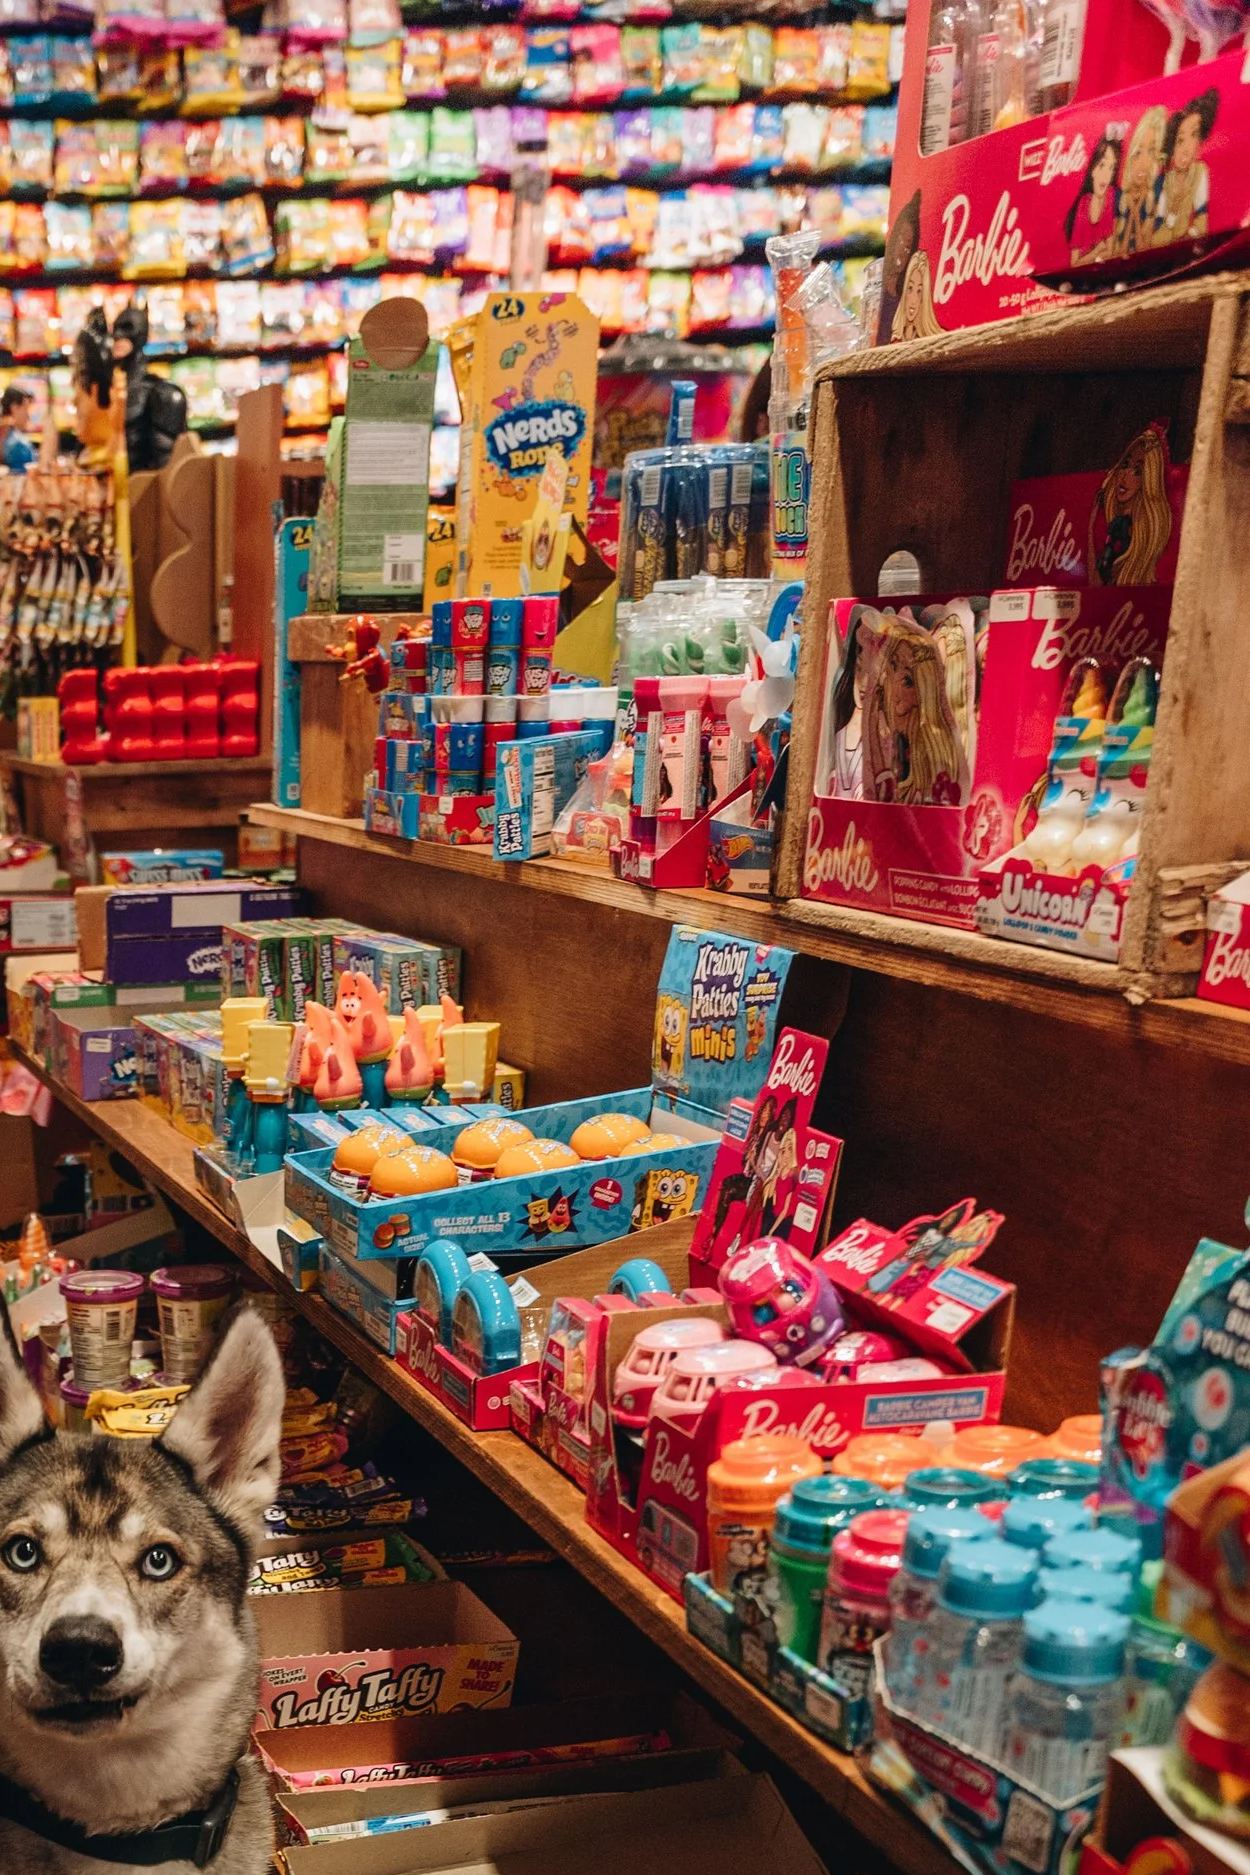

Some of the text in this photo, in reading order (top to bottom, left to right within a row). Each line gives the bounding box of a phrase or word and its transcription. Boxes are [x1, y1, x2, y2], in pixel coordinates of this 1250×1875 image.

[933, 190, 1030, 304] Barbie
[1006, 503, 1082, 582] Barbie
[1031, 600, 1158, 671] Barbie
[498, 814, 511, 855] Krabby
[803, 806, 879, 892] Barbie
[290, 946, 301, 983] Patties
[694, 942, 749, 988] Krabby
[322, 978, 335, 1011] rabby
[690, 983, 740, 1019] Patties
[690, 1024, 737, 1063] minis
[767, 1034, 816, 1096] Barbie
[397, 1233, 429, 1247] ACTUAL
[433, 1216, 474, 1227] COLLECT
[478, 1214, 495, 1225] ALL
[439, 1223, 504, 1236] CHARACTERS!
[822, 1228, 886, 1275] Barbie
[408, 1321, 440, 1384] Barbie
[741, 1398, 850, 1448] Barbie
[651, 1430, 700, 1502] Barbie
[273, 1676, 308, 1687] WRAPPER
[282, 1669, 304, 1679] EVERY
[468, 1658, 504, 1673] MADE
[477, 1671, 491, 1681] TO
[276, 1665, 443, 1728] Laffy Taffy
[460, 1679, 500, 1692] SHARE!
[368, 1702, 395, 1714] CANDY
